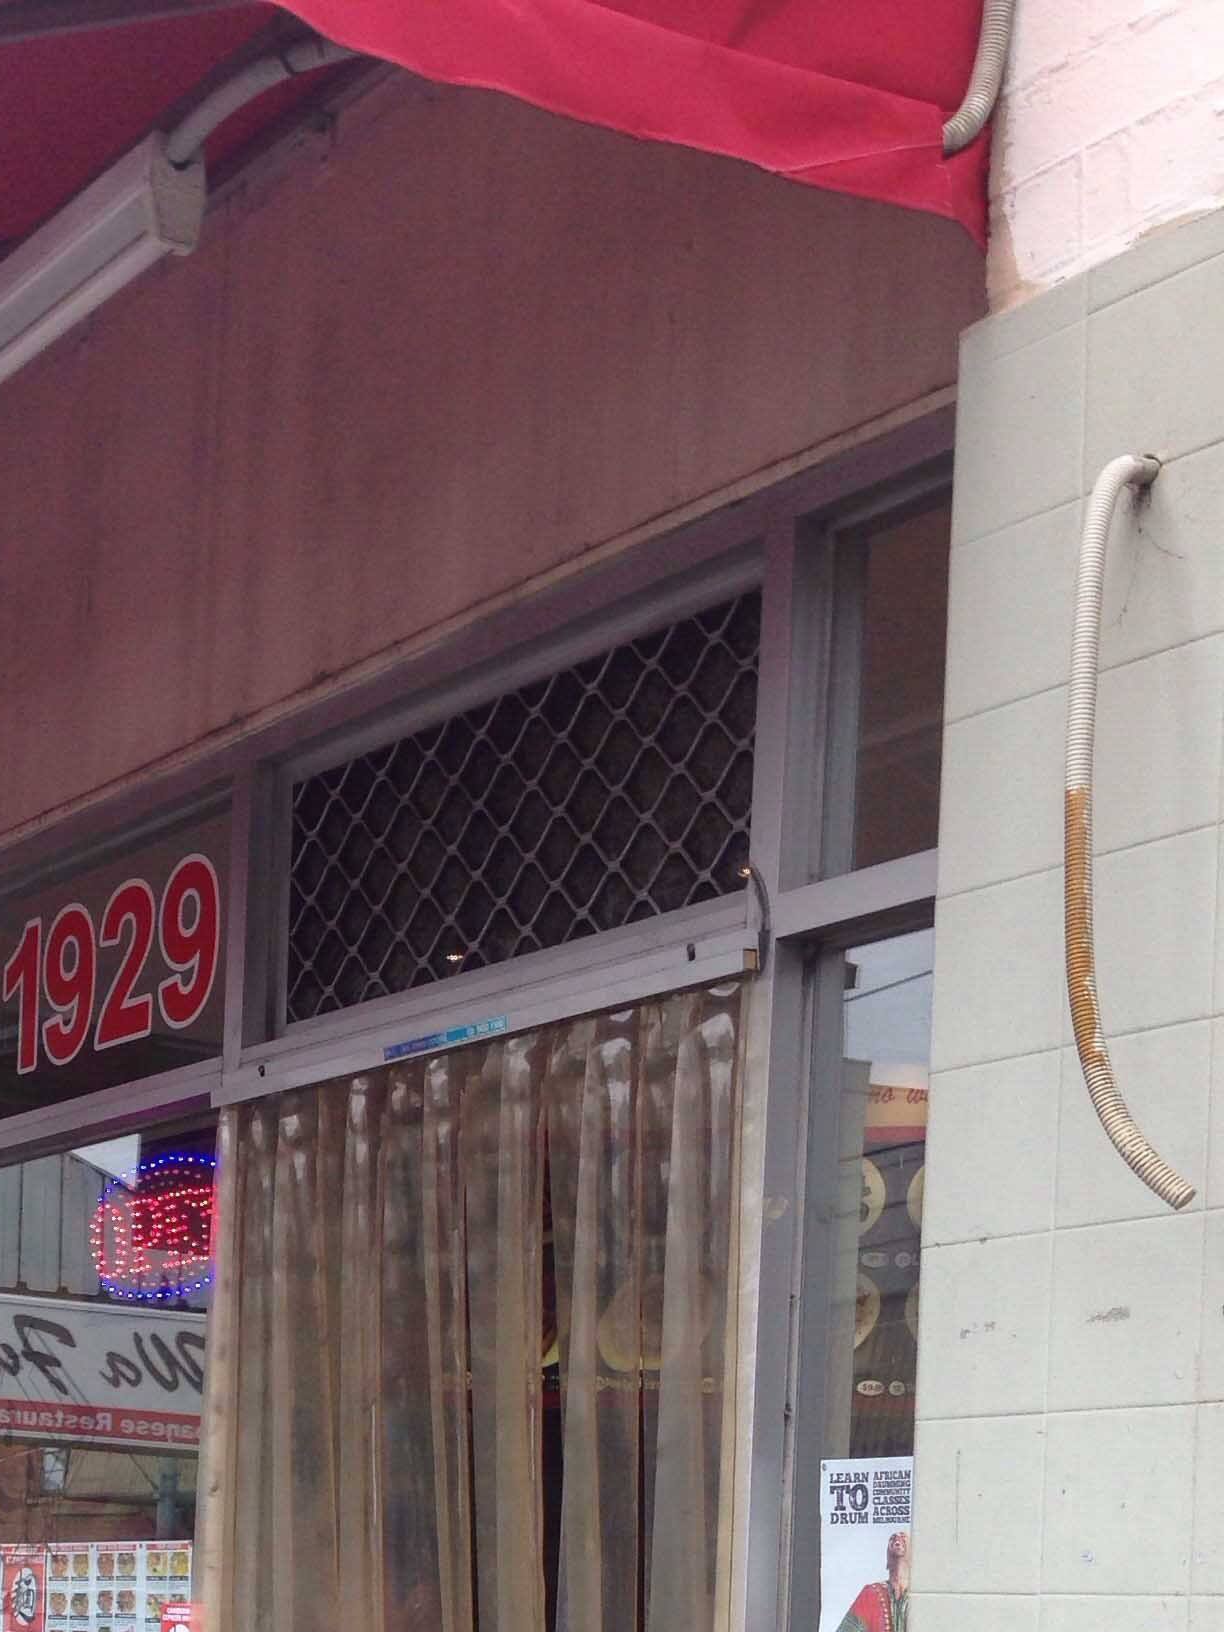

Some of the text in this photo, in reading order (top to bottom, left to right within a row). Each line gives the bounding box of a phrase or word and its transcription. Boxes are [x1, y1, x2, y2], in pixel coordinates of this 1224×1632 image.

[3, 853, 220, 1076] 1929
[829, 1471, 869, 1484] LEARN
[872, 1470, 911, 1481] AFRICAN
[829, 1483, 869, 1512] TO
[872, 1495, 911, 1506] CLASSES
[872, 1505, 910, 1516] ACROSS
[830, 1512, 869, 1525] DRUM
